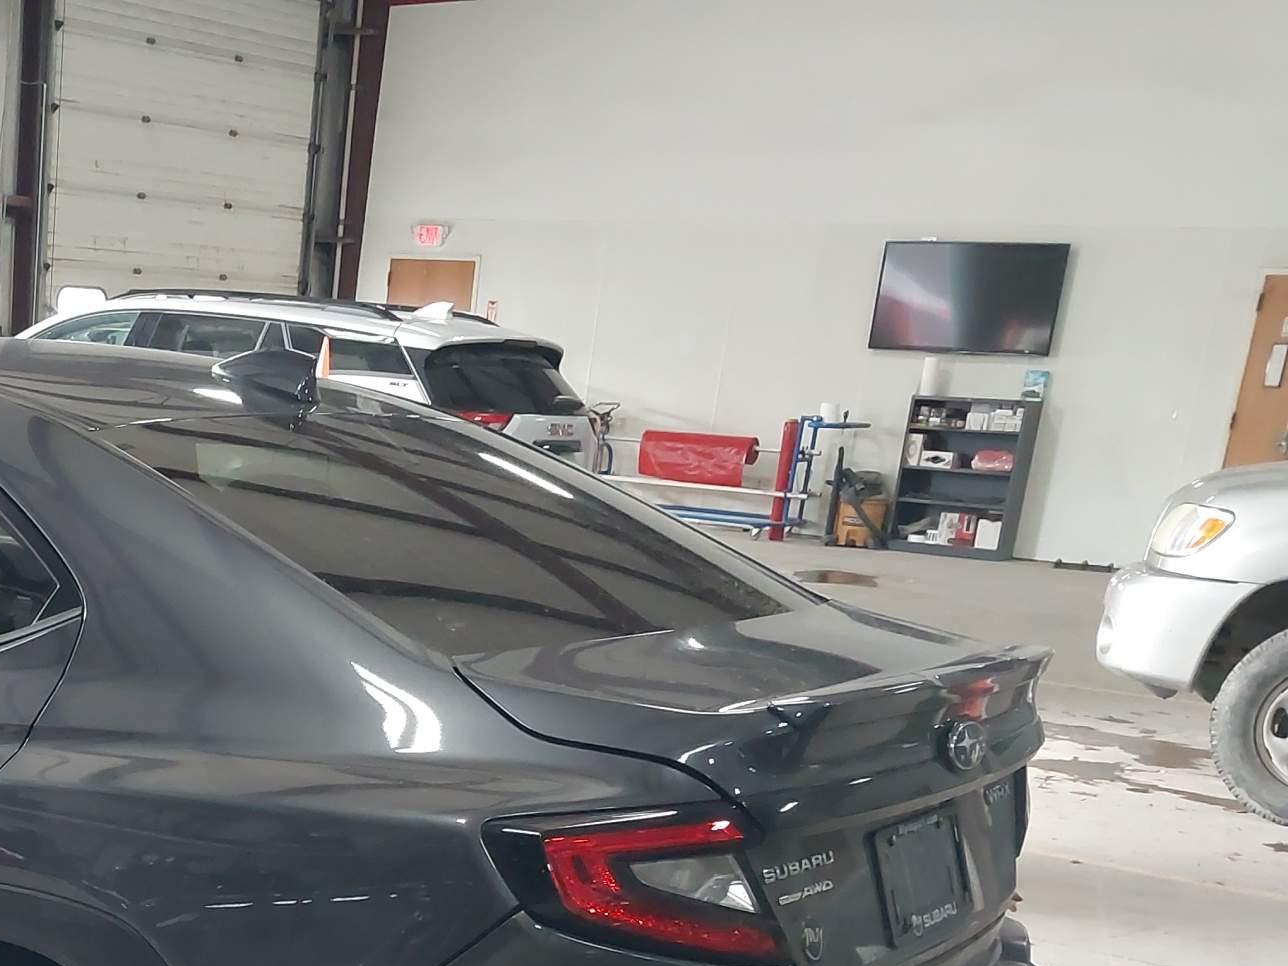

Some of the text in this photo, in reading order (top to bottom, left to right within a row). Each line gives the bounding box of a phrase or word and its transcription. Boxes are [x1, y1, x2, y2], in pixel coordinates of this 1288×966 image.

[762, 850, 835, 885] SUBARU
[801, 880, 834, 899] AWD
[922, 901, 958, 928] SUBARU
